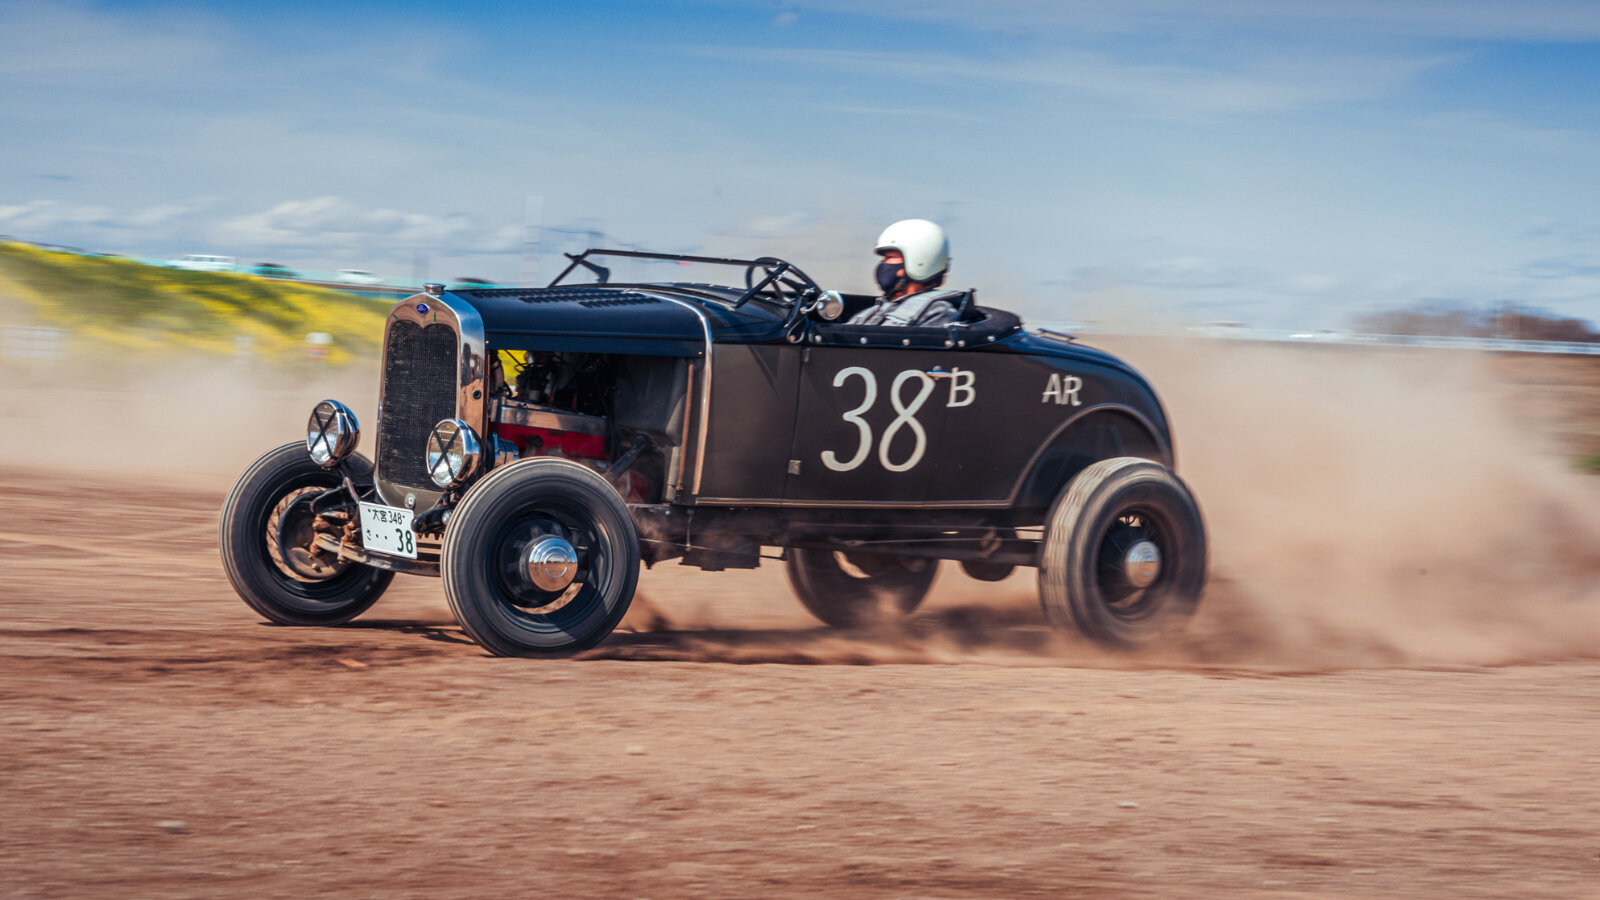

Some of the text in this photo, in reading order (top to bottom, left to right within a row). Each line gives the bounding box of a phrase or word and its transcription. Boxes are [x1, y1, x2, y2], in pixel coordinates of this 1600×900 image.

[821, 366, 976, 472] 38 B
[1041, 373, 1083, 406] AR
